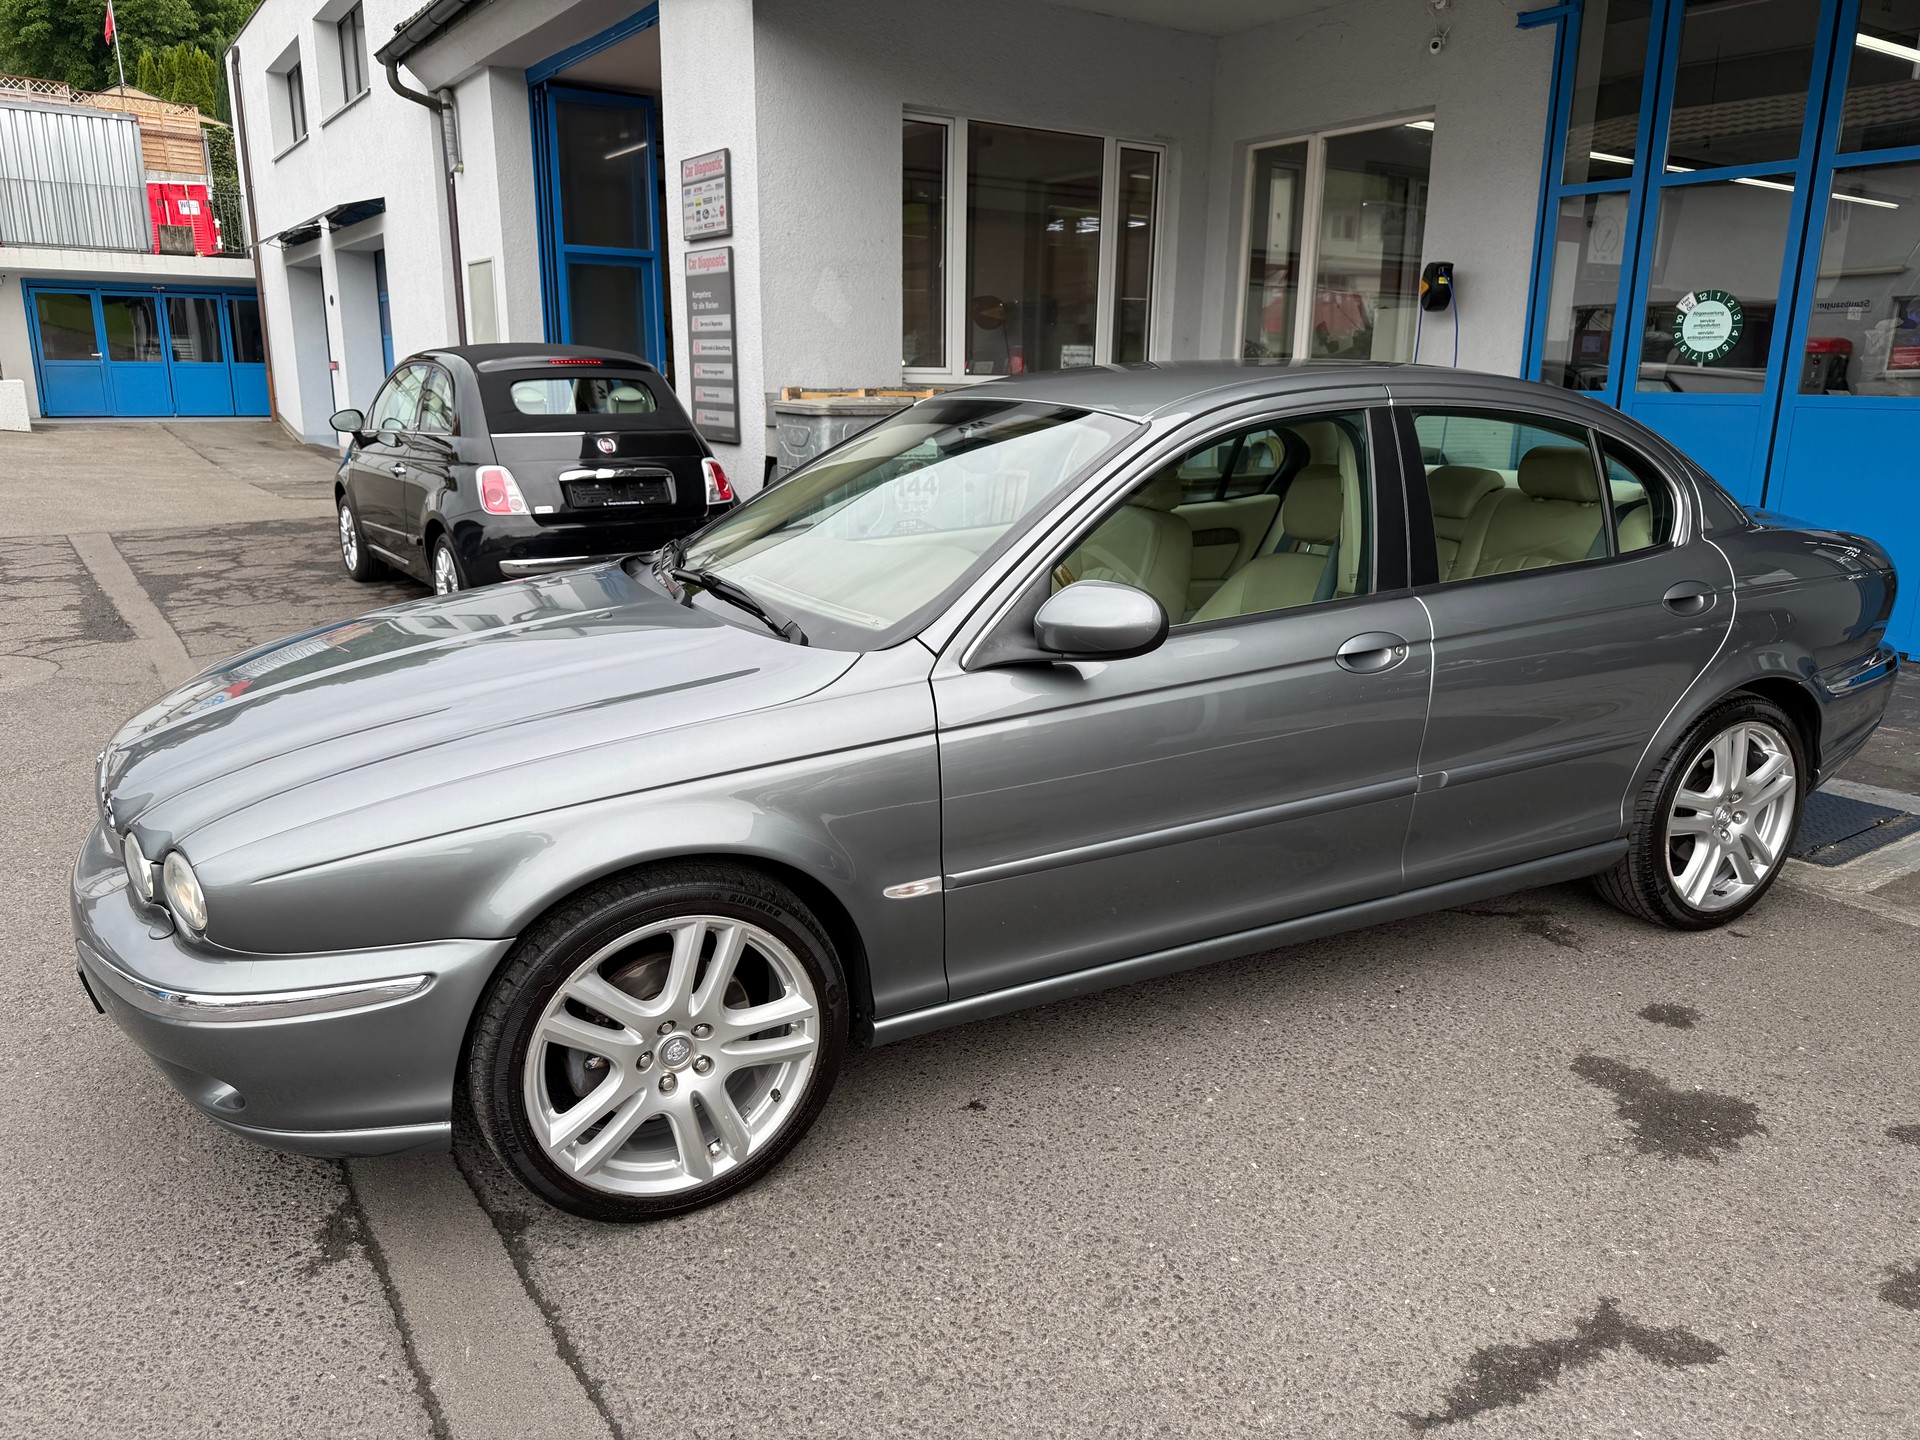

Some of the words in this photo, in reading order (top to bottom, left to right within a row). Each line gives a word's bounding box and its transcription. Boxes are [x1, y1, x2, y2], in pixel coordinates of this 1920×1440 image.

[685, 165, 693, 177] Car
[694, 156, 723, 176] Diagnostic
[688, 258, 697, 270] Car
[698, 253, 726, 271] Diagnostic
[692, 291, 712, 299] Kompetenz
[1698, 293, 1708, 301] 12
[705, 301, 719, 309] Marken
[1675, 314, 1684, 324] 10
[728, 893, 782, 918] SUMMER
